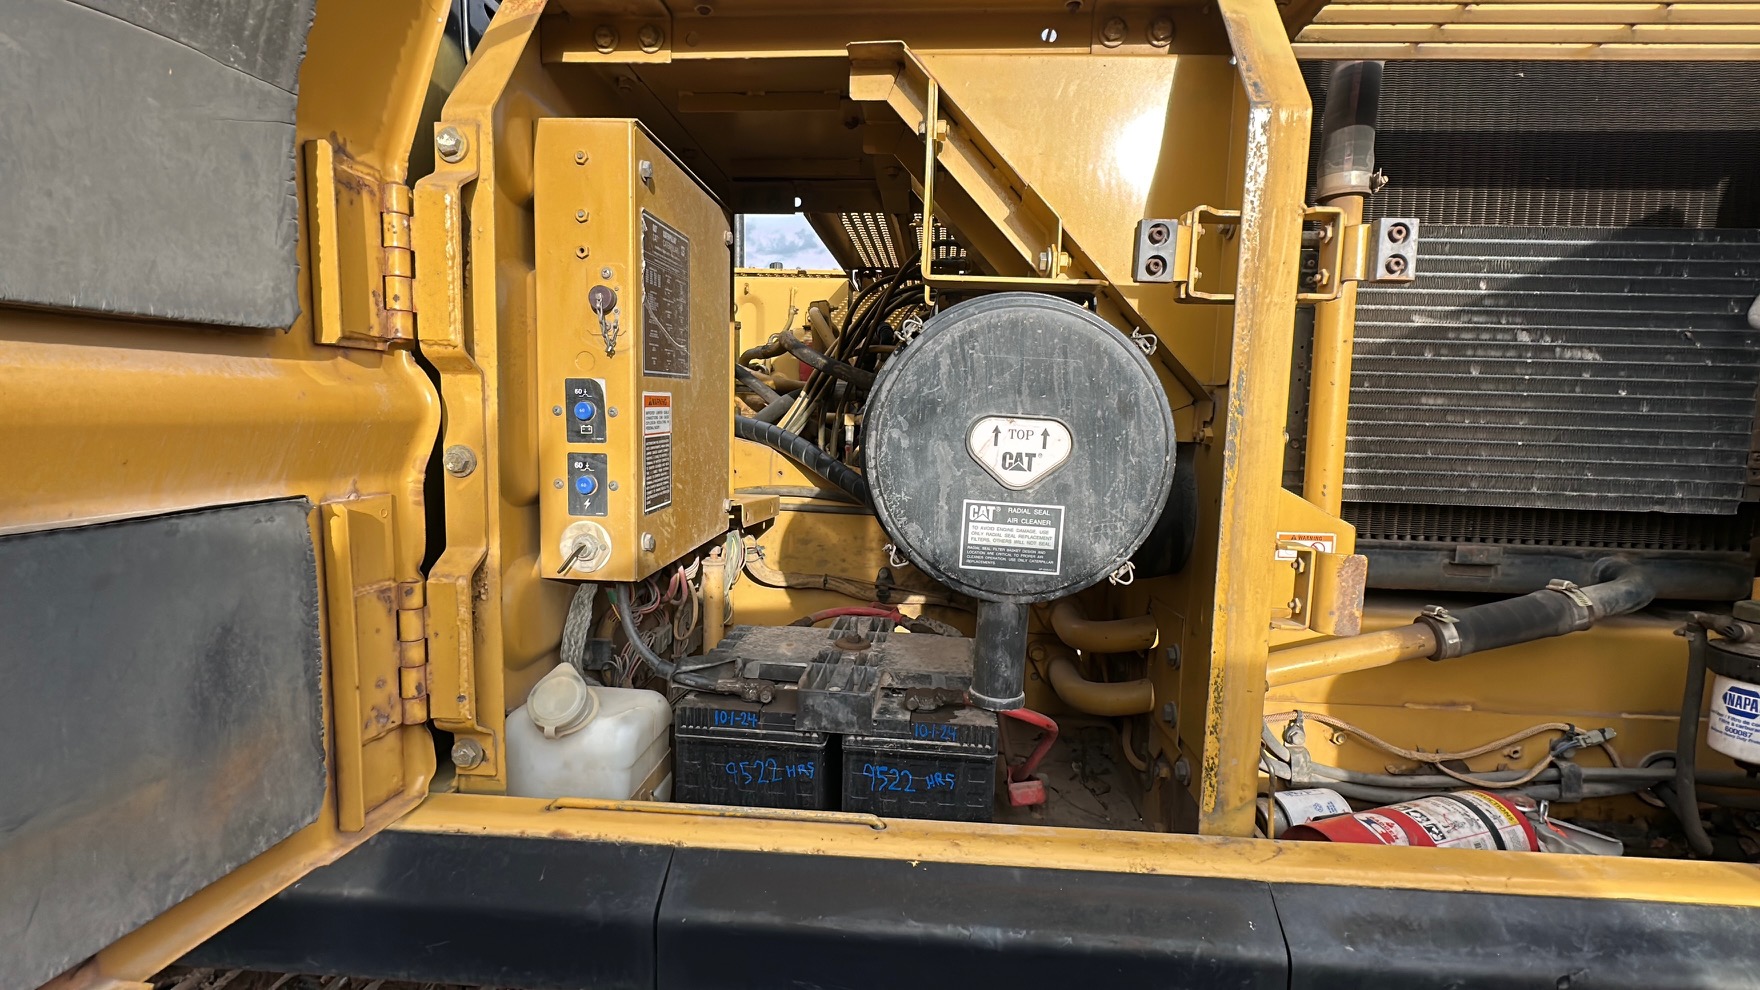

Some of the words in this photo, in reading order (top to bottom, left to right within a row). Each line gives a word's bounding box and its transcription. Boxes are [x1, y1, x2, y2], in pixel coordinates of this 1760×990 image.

[1008, 428, 1035, 441] TOP
[574, 461, 584, 469] 60
[1726, 692, 1759, 713] NAPA
[1724, 726, 1752, 738] 600087
[725, 758, 783, 785] 9522
[786, 762, 814, 779] HRS
[862, 763, 916, 792] 9522
[926, 772, 954, 790] HRS
